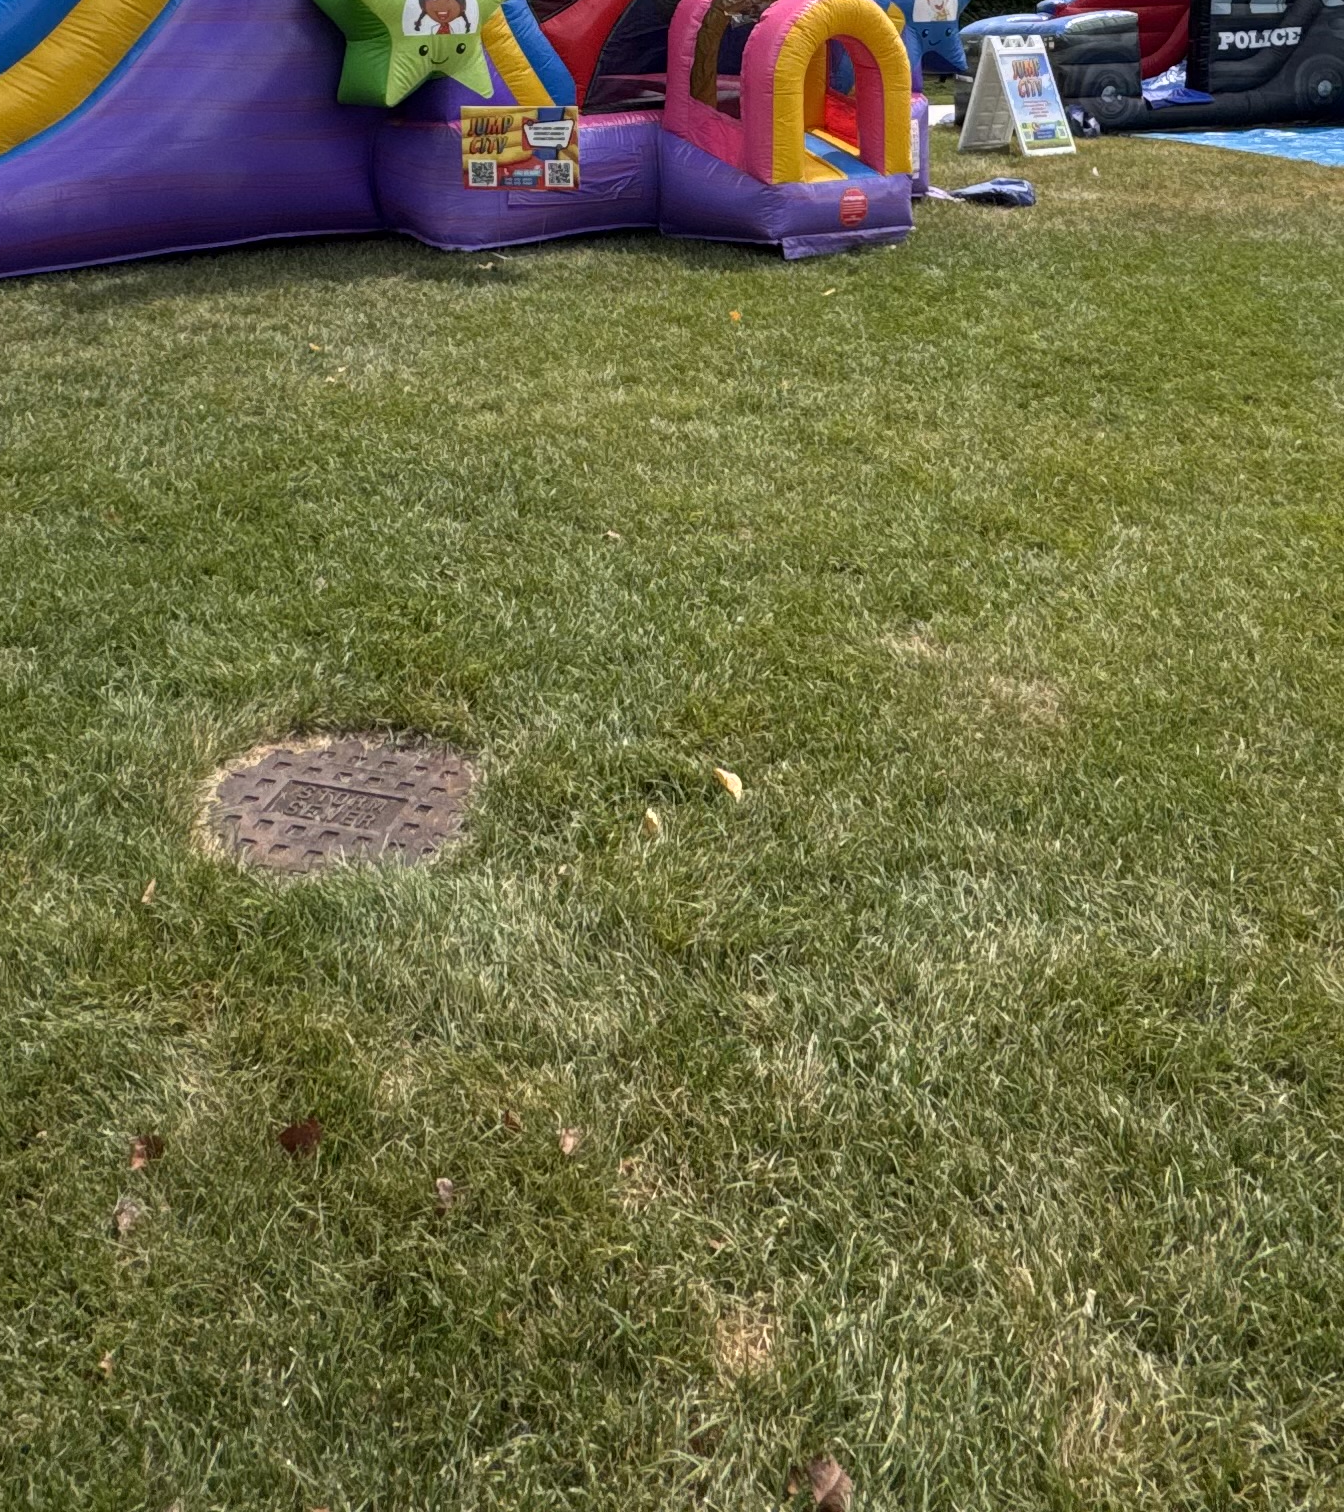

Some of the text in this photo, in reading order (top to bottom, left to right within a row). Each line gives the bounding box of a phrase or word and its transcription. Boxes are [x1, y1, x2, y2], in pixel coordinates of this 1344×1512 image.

[1217, 26, 1302, 50] POLICE
[468, 115, 514, 137] JUMP
[469, 135, 508, 155] CITY
[296, 786, 387, 814] STORM
[282, 800, 375, 829] SEWER
